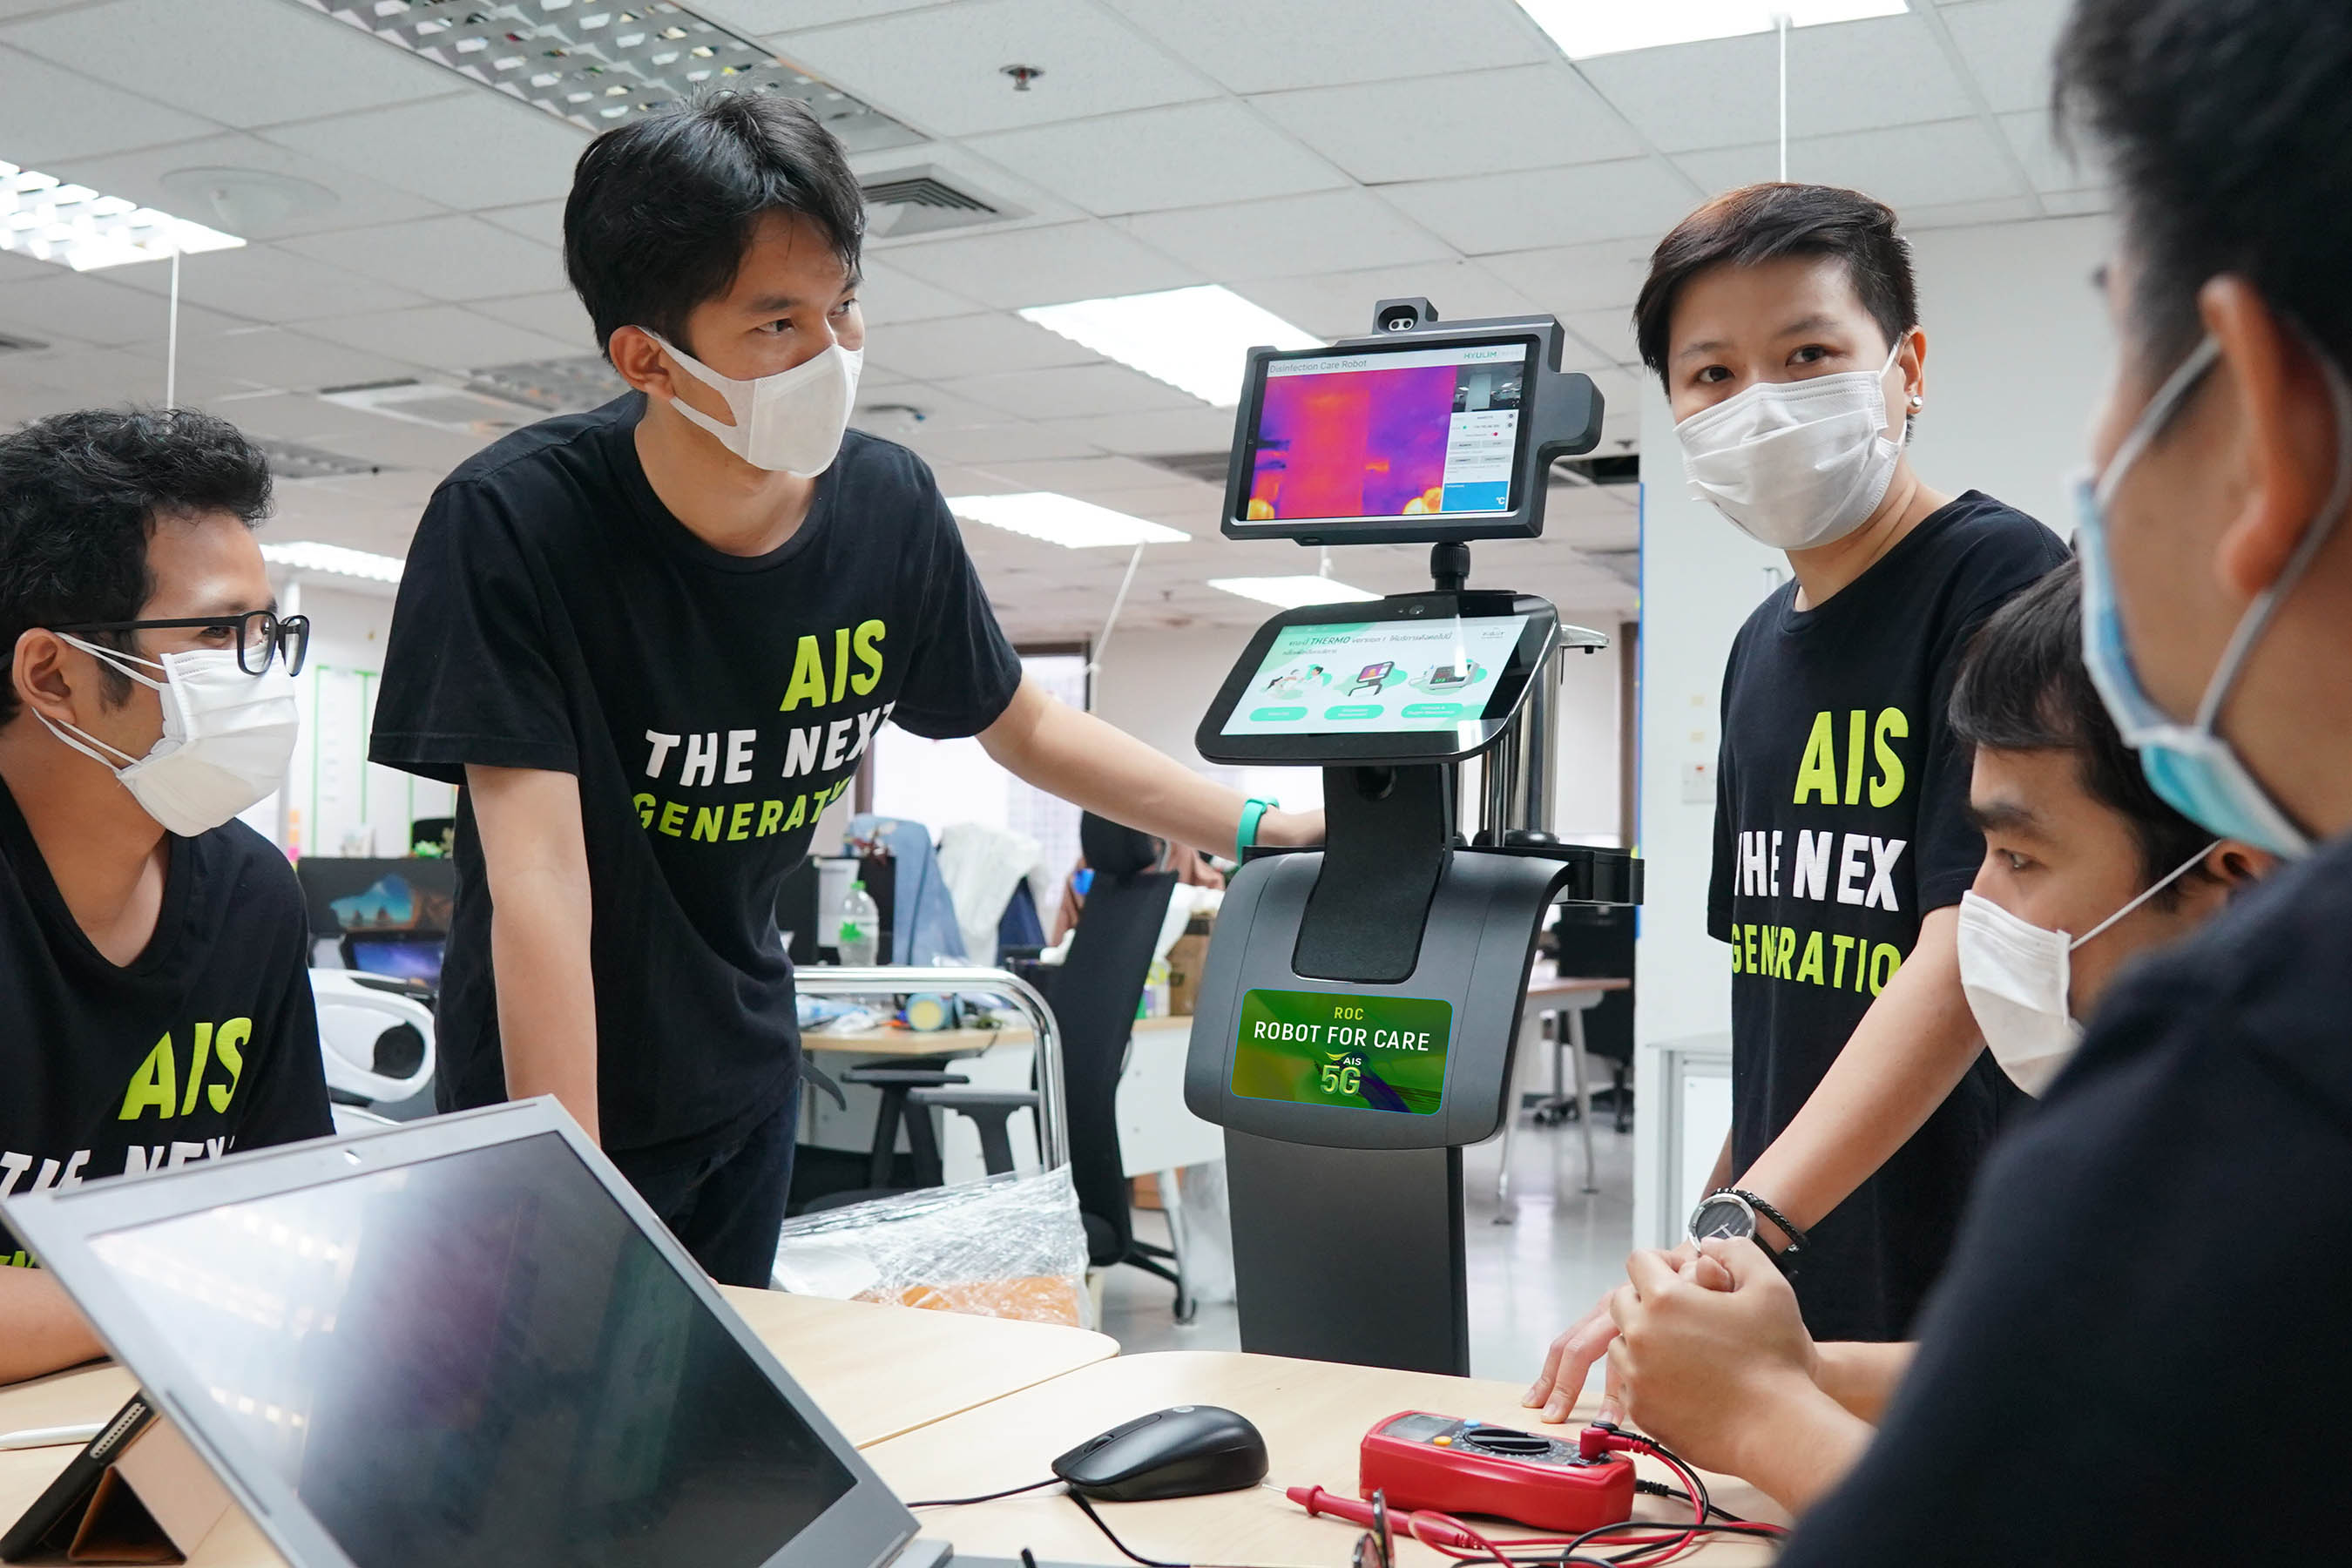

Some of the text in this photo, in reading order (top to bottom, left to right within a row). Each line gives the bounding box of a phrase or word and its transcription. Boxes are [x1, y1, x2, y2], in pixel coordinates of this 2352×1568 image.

[1269, 359, 1367, 373] Disinfection Care Robot
[1310, 636, 1351, 645] THERMO
[780, 619, 886, 712] AIS
[645, 729, 756, 787] THE
[1793, 706, 1909, 808] AIS
[1734, 830, 1783, 897] HE
[1254, 1021, 1430, 1051] ROBOT FOR CARE
[1335, 1007, 1364, 1021] ROC
[118, 1017, 252, 1120] AIS
[1320, 1064, 1362, 1097] 5G
